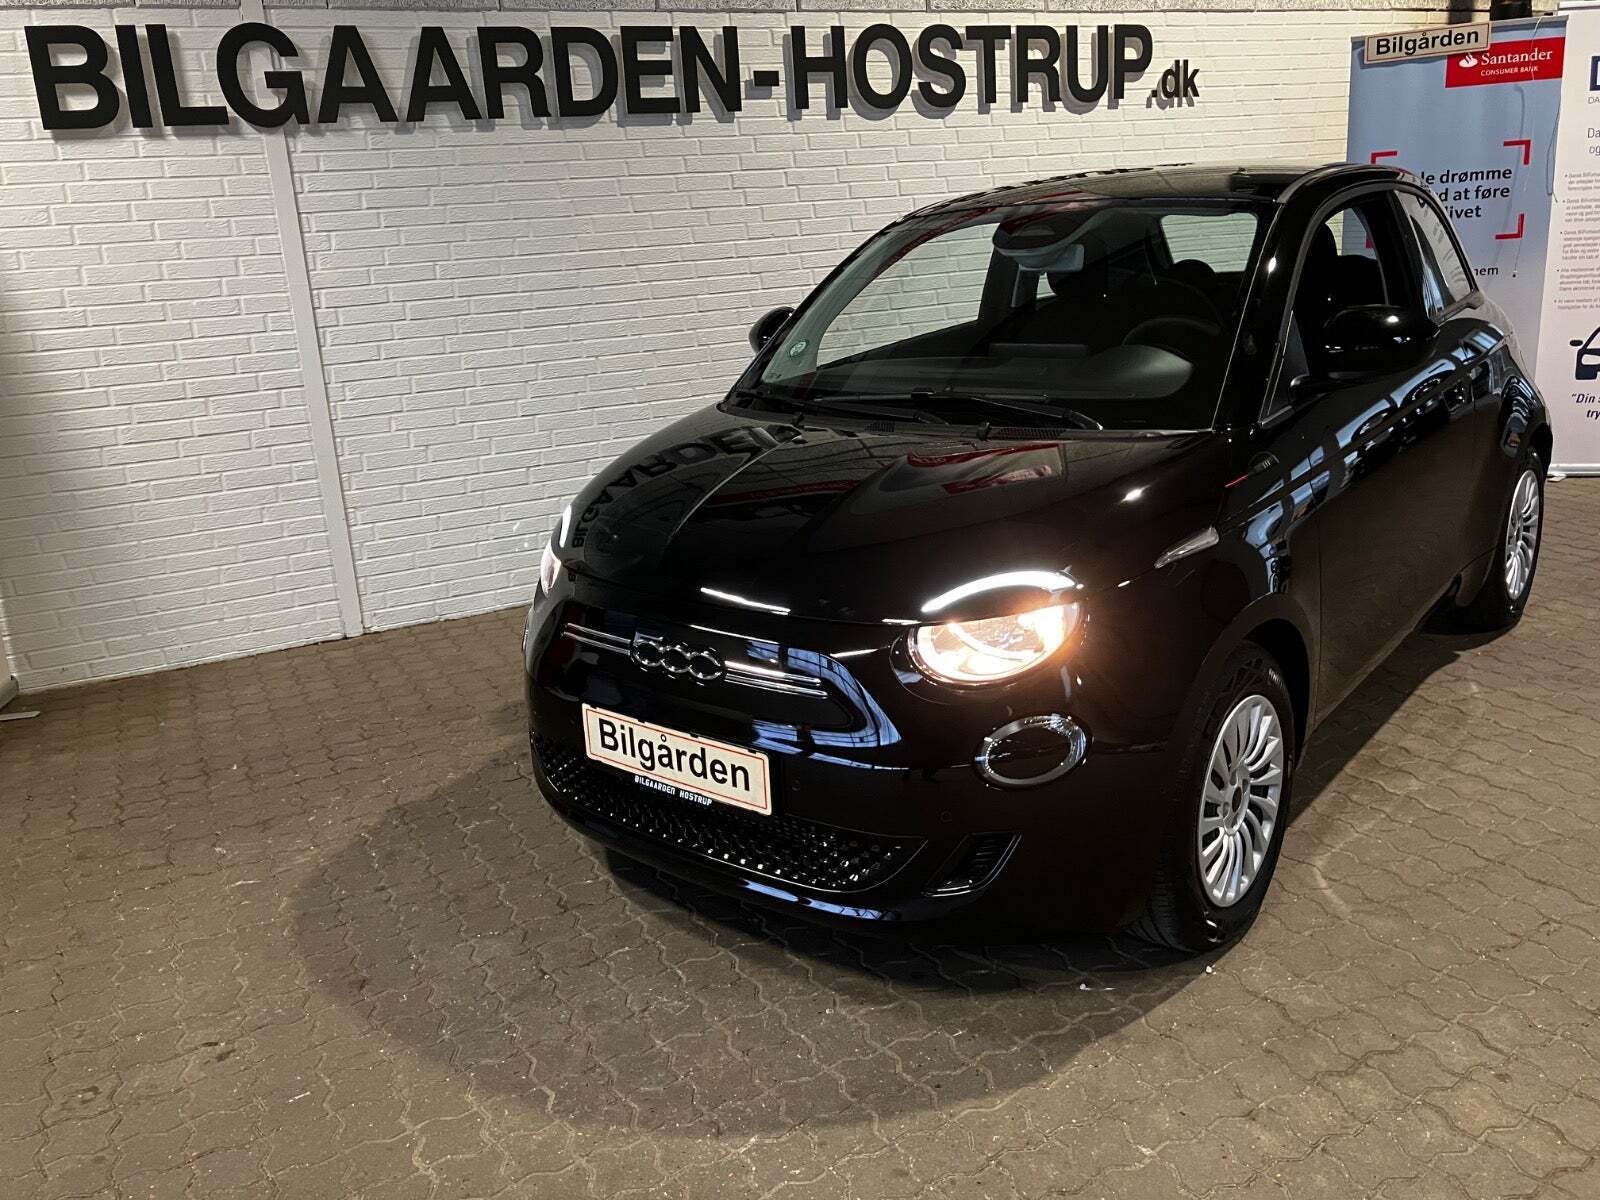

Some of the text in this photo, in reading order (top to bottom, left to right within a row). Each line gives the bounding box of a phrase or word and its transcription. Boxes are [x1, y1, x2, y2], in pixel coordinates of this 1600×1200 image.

[1376, 30, 1479, 55] Bilgården
[1481, 48, 1553, 65] Santander
[1480, 67, 1518, 76] CONSUMER
[1440, 169, 1513, 184] drømme
[1453, 187, 1470, 200] at
[1475, 185, 1510, 199] føre
[598, 717, 750, 792] Bilgården
[634, 775, 713, 806] BILGAARDEN HOSTRUP
